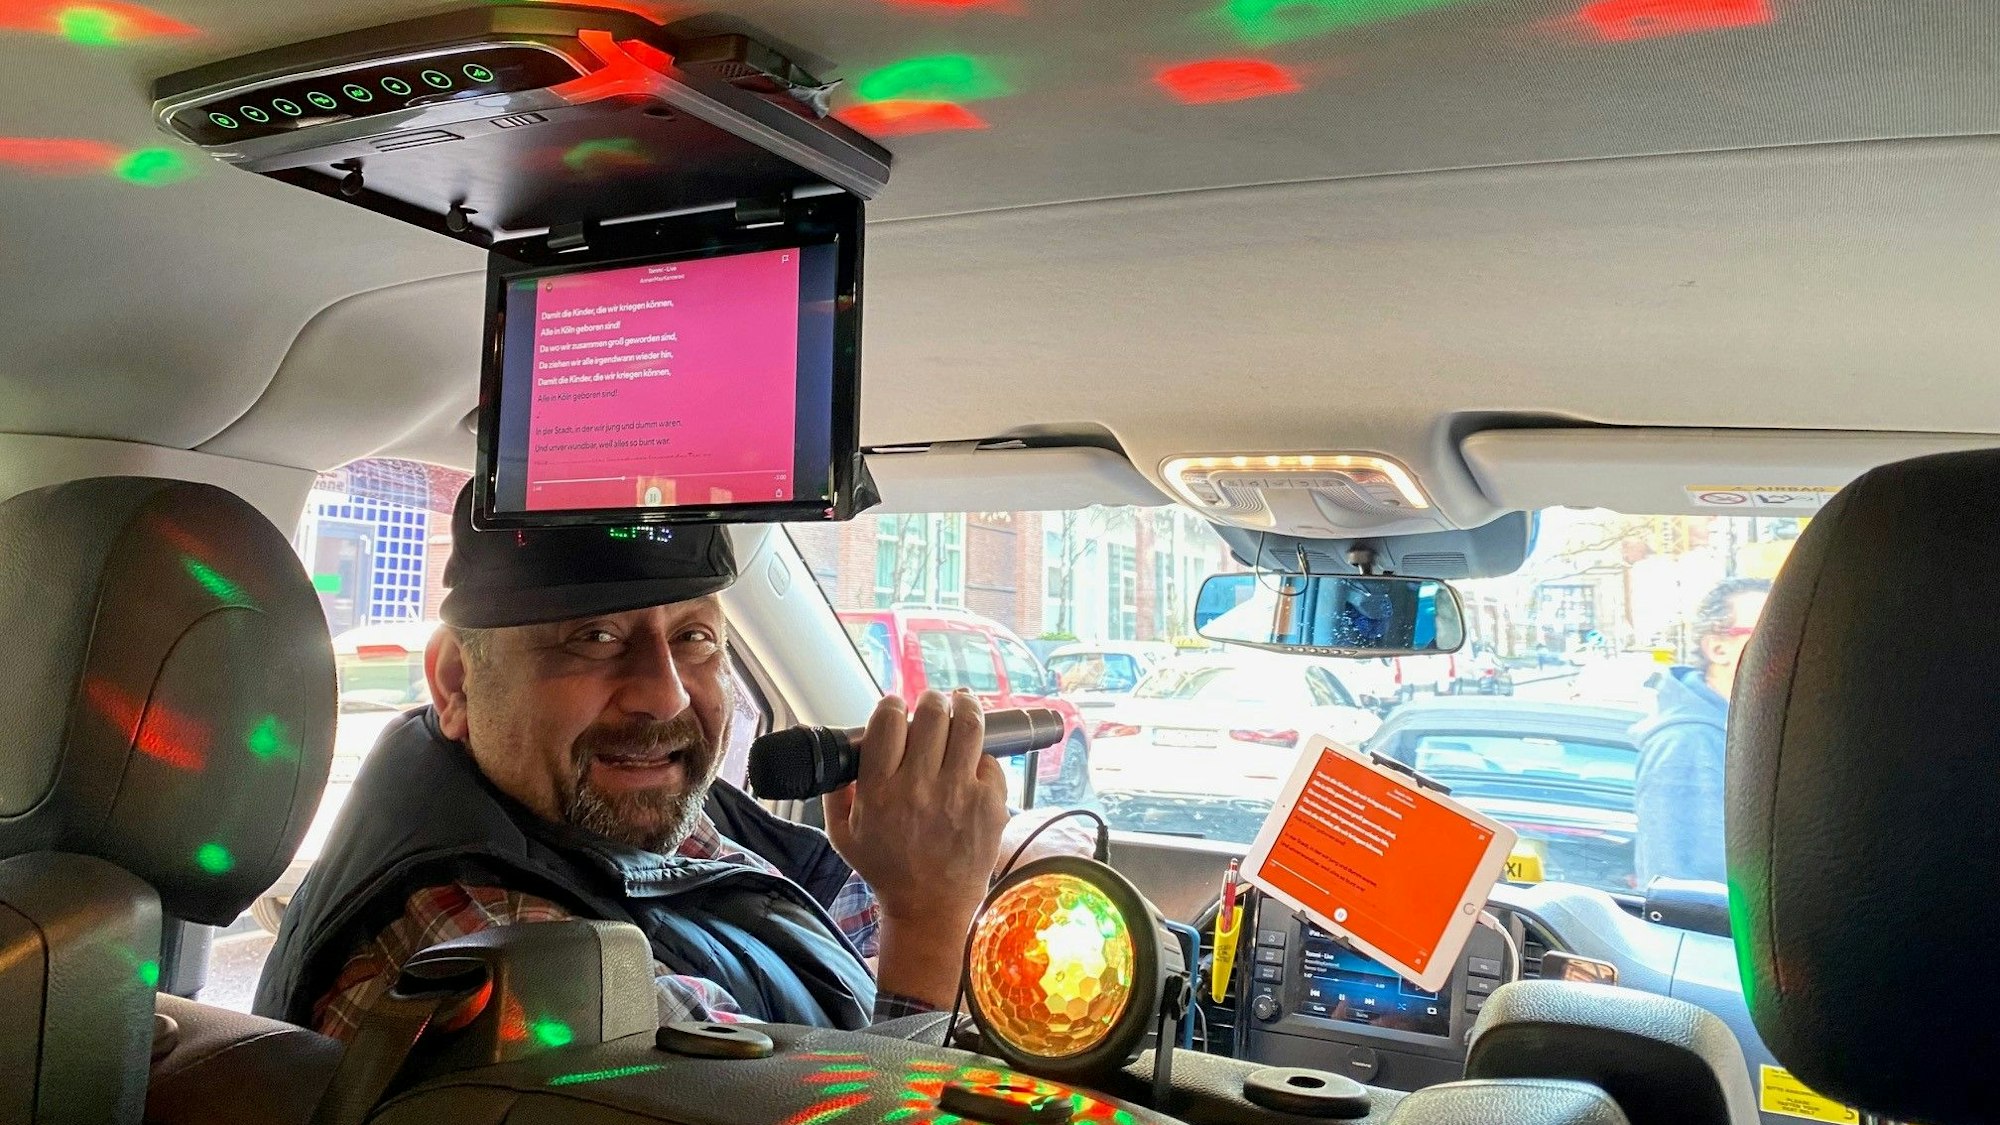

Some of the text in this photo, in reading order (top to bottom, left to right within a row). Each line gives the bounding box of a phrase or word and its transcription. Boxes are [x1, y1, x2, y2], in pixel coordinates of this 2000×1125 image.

[542, 300, 674, 320] Damit die Kinder, die wir kriegen können,
[541, 328, 553, 336] Alle
[561, 325, 575, 334] Köln
[576, 323, 604, 335] geboren
[540, 345, 549, 353] Da
[572, 341, 607, 350] zusammen
[608, 337, 624, 348] groß
[625, 334, 660, 347] geworden
[661, 332, 678, 342] sind,
[539, 361, 548, 369] Da
[549, 360, 570, 368] ziehen
[582, 357, 593, 365] alle
[594, 354, 634, 366] irgendwann
[636, 351, 660, 360] wieder
[660, 350, 673, 359] hin,
[538, 368, 671, 386] Damit die Kinder, die wir kriegen können,
[538, 394, 550, 403] Alle
[558, 393, 572, 401] Köln
[573, 391, 600, 402] geboren
[602, 389, 618, 397] sind!
[606, 424, 620, 432] jung
[622, 421, 634, 430] und
[636, 420, 657, 428] dumm
[535, 444, 548, 452] Und
[549, 442, 598, 451] unverwundbar,
[599, 440, 612, 448] weil
[640, 437, 654, 446] bunt
[1506, 862, 1521, 877] XI
